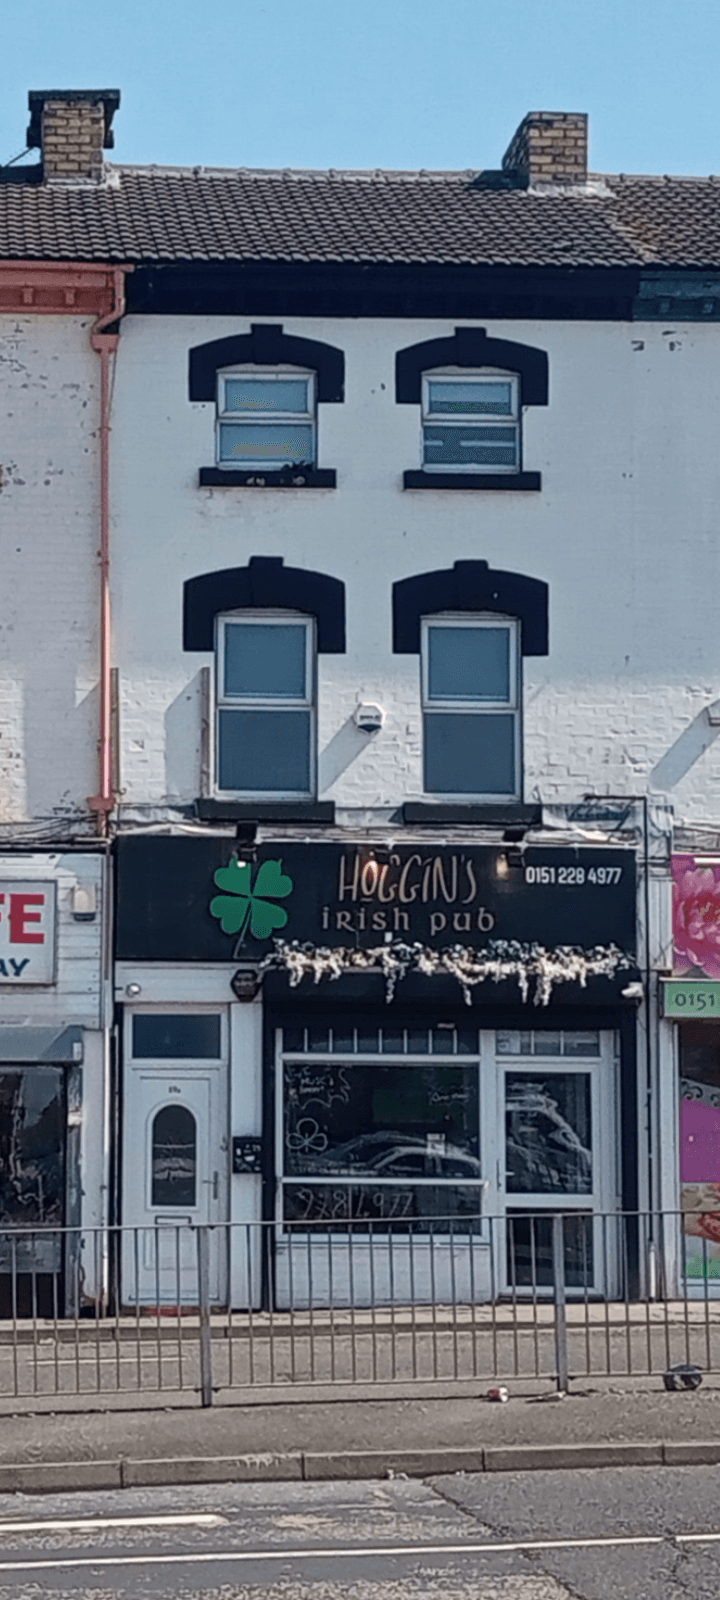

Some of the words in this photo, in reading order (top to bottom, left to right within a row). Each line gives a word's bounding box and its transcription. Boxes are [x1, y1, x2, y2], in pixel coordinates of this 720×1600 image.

[525, 866, 555, 884] 0151
[558, 867, 585, 885] 228
[587, 867, 622, 885] 4977
[0, 893, 45, 944] E
[674, 993, 716, 1011] 0151
